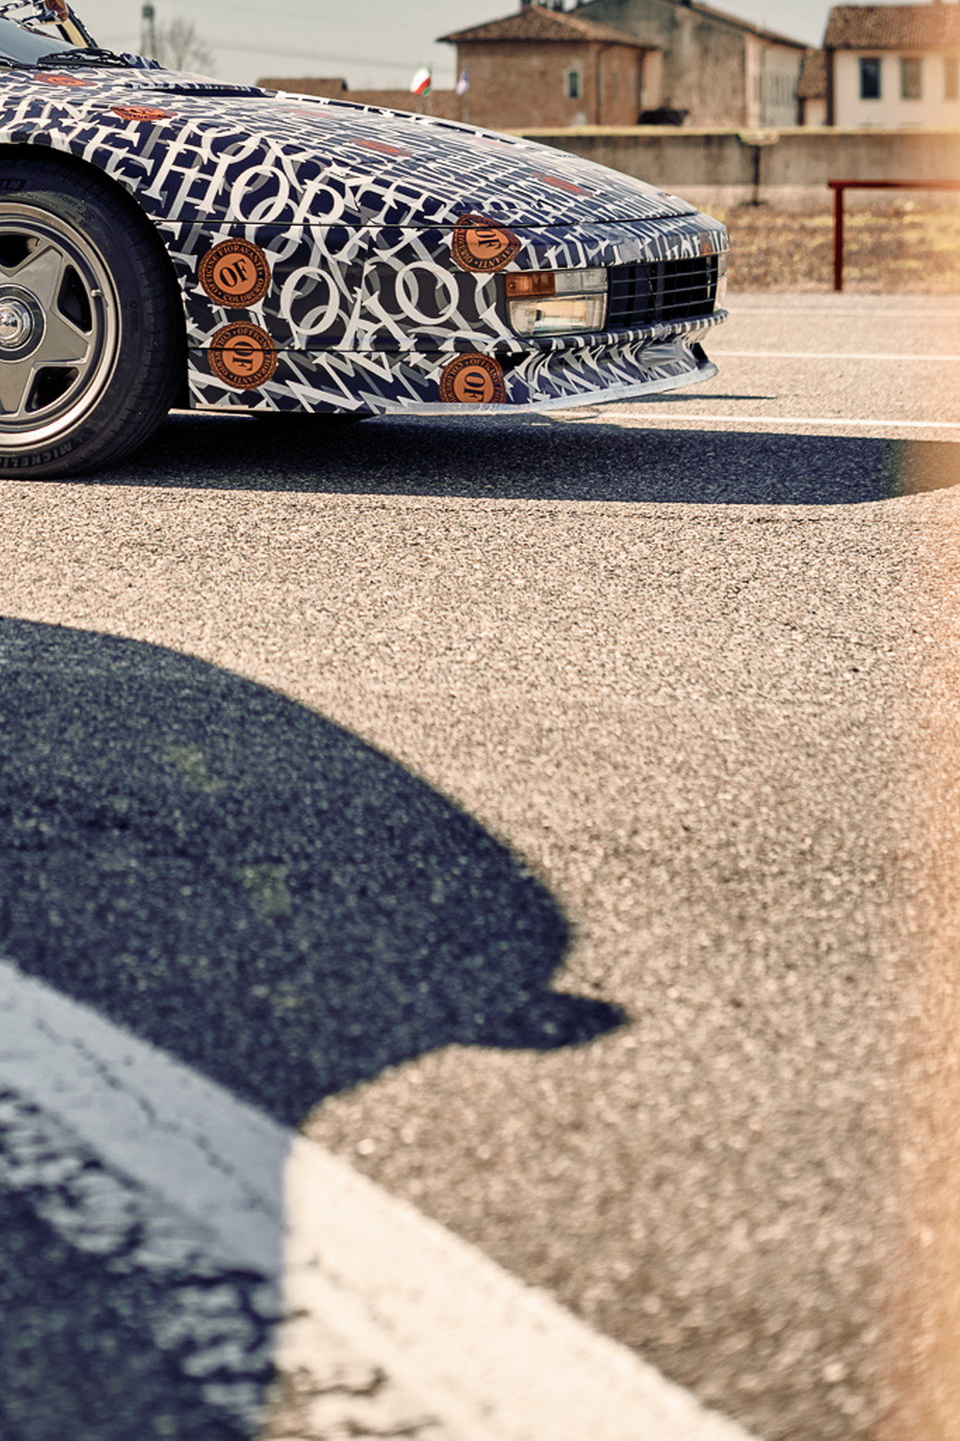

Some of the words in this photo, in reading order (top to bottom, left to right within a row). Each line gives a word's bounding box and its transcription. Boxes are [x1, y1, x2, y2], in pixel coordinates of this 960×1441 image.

[218, 244, 264, 272] FIORAVANTI
[219, 258, 248, 288] OF
[232, 341, 254, 371] OF
[463, 371, 486, 402] OF
